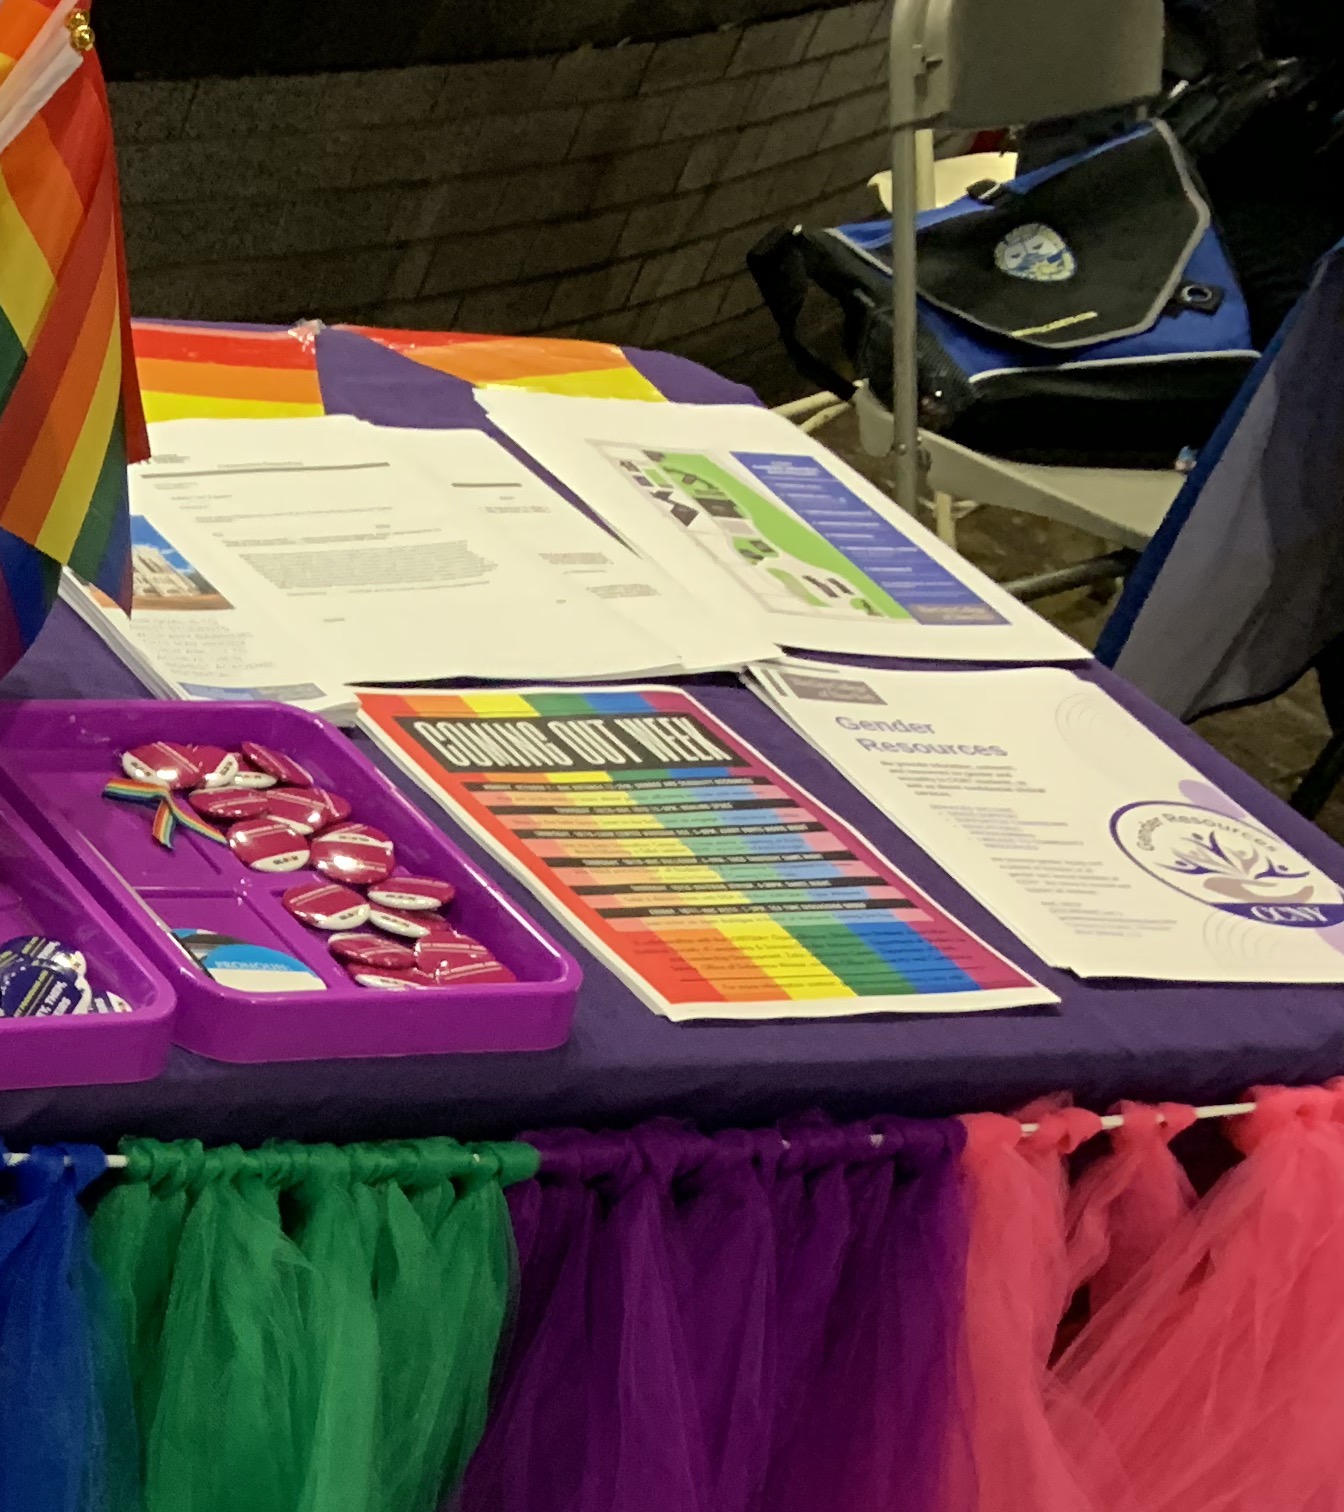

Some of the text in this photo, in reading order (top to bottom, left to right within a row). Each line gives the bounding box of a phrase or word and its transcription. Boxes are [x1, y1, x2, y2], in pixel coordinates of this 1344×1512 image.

[835, 715, 937, 735] Gender
[413, 716, 733, 768] COMING OUT WEEK
[855, 737, 1009, 758] Resources
[1135, 812, 1279, 853] Gender Resources
[1249, 904, 1330, 923] CCNY
